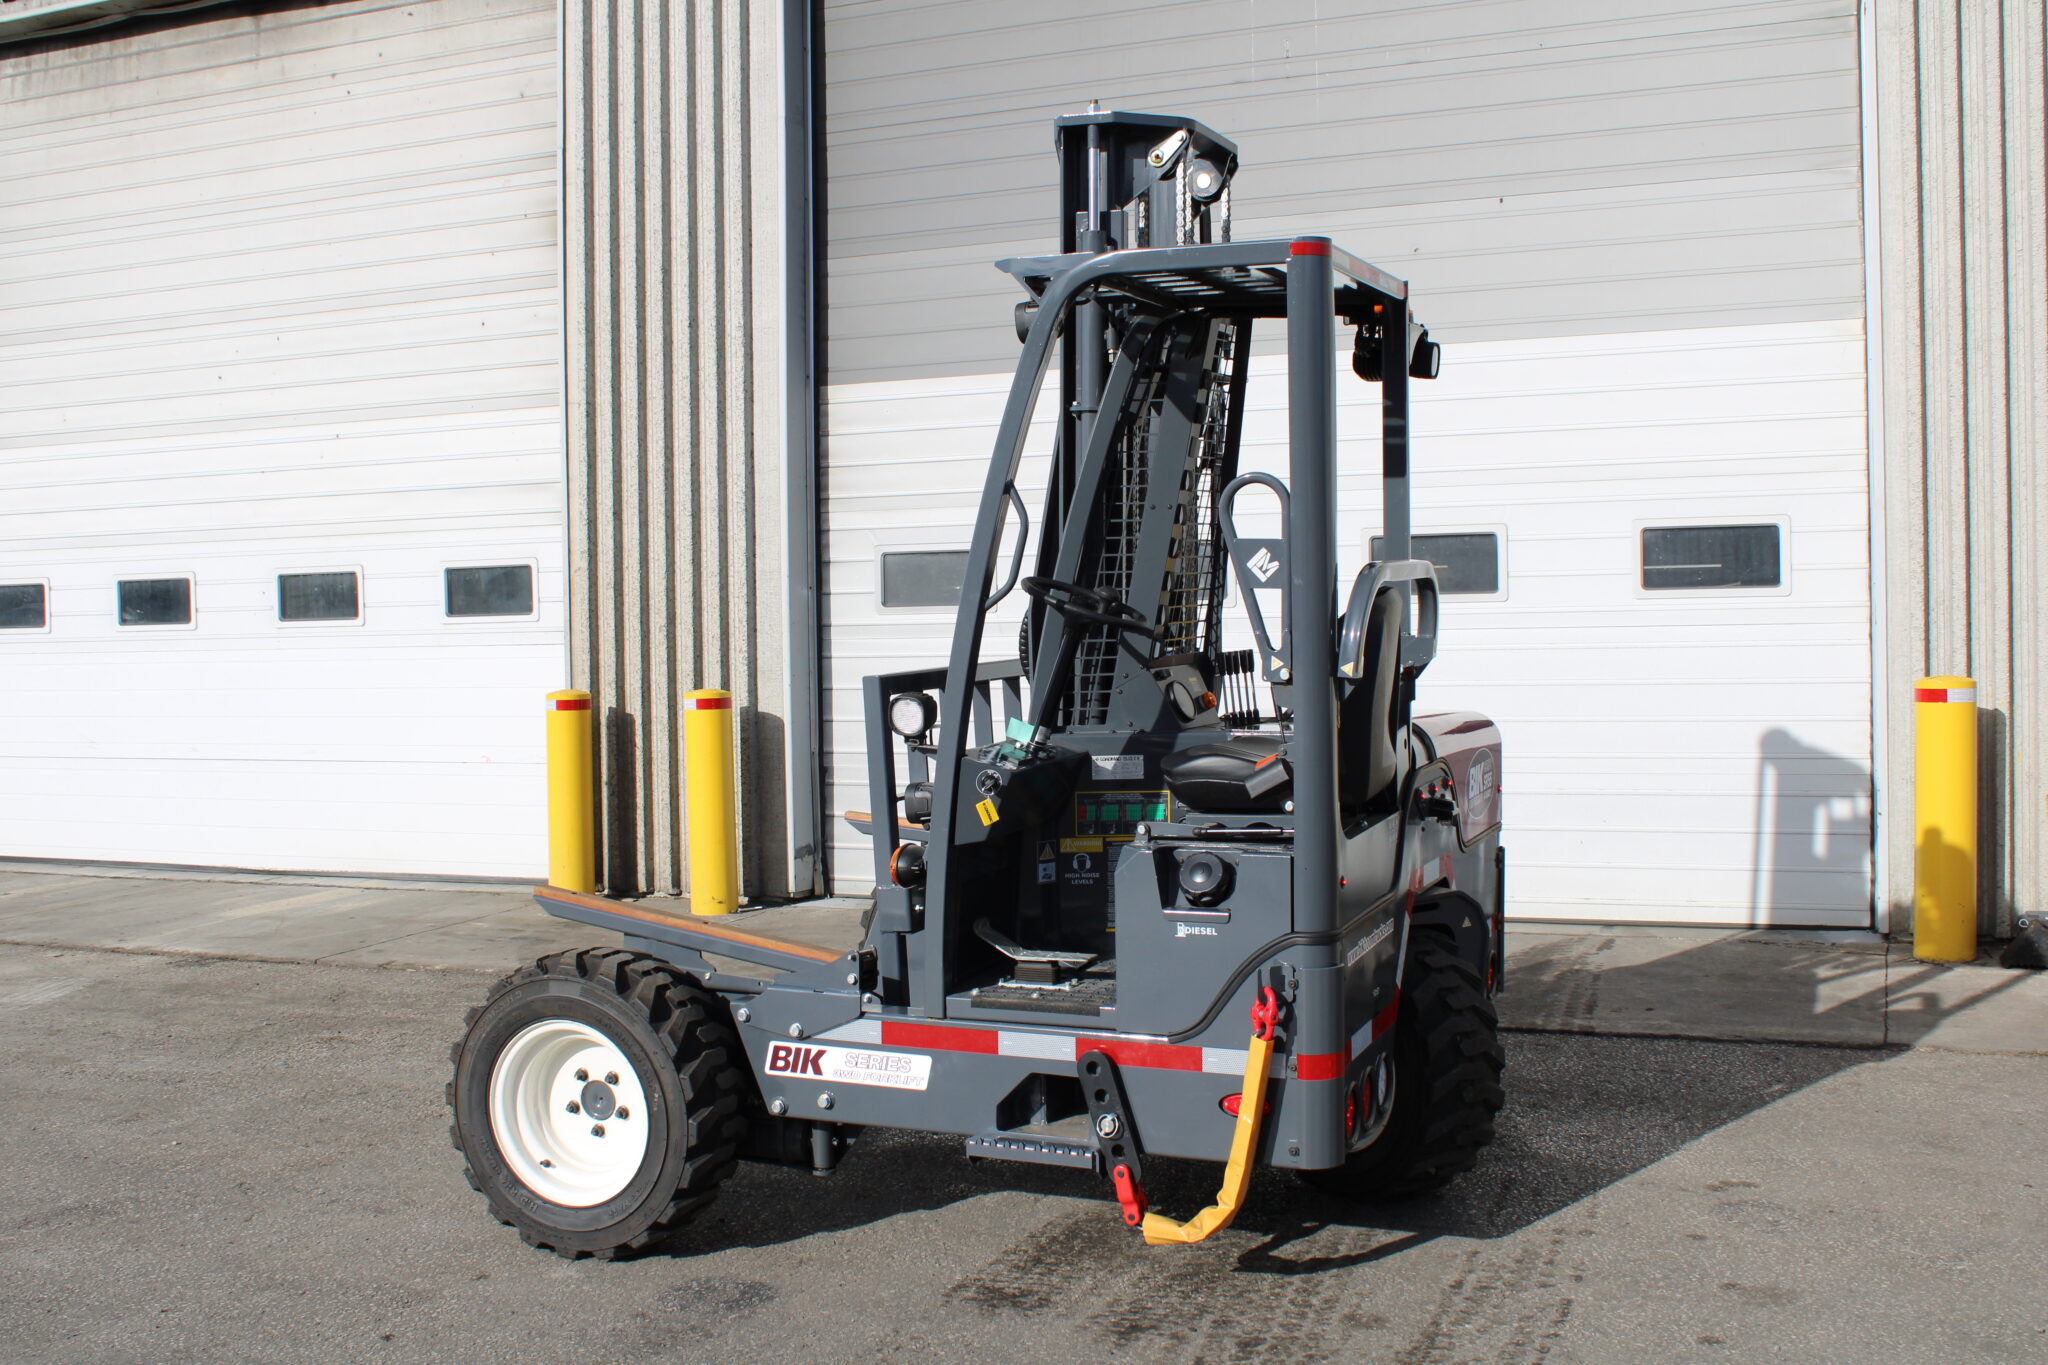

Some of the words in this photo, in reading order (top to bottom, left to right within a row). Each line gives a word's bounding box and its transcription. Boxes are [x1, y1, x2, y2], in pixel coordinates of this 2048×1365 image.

[1184, 926, 1218, 936] DIESEL
[769, 1045, 827, 1076] BIK
[845, 1052, 912, 1073] SERIES
[863, 1071, 925, 1086] FORKLIFT
